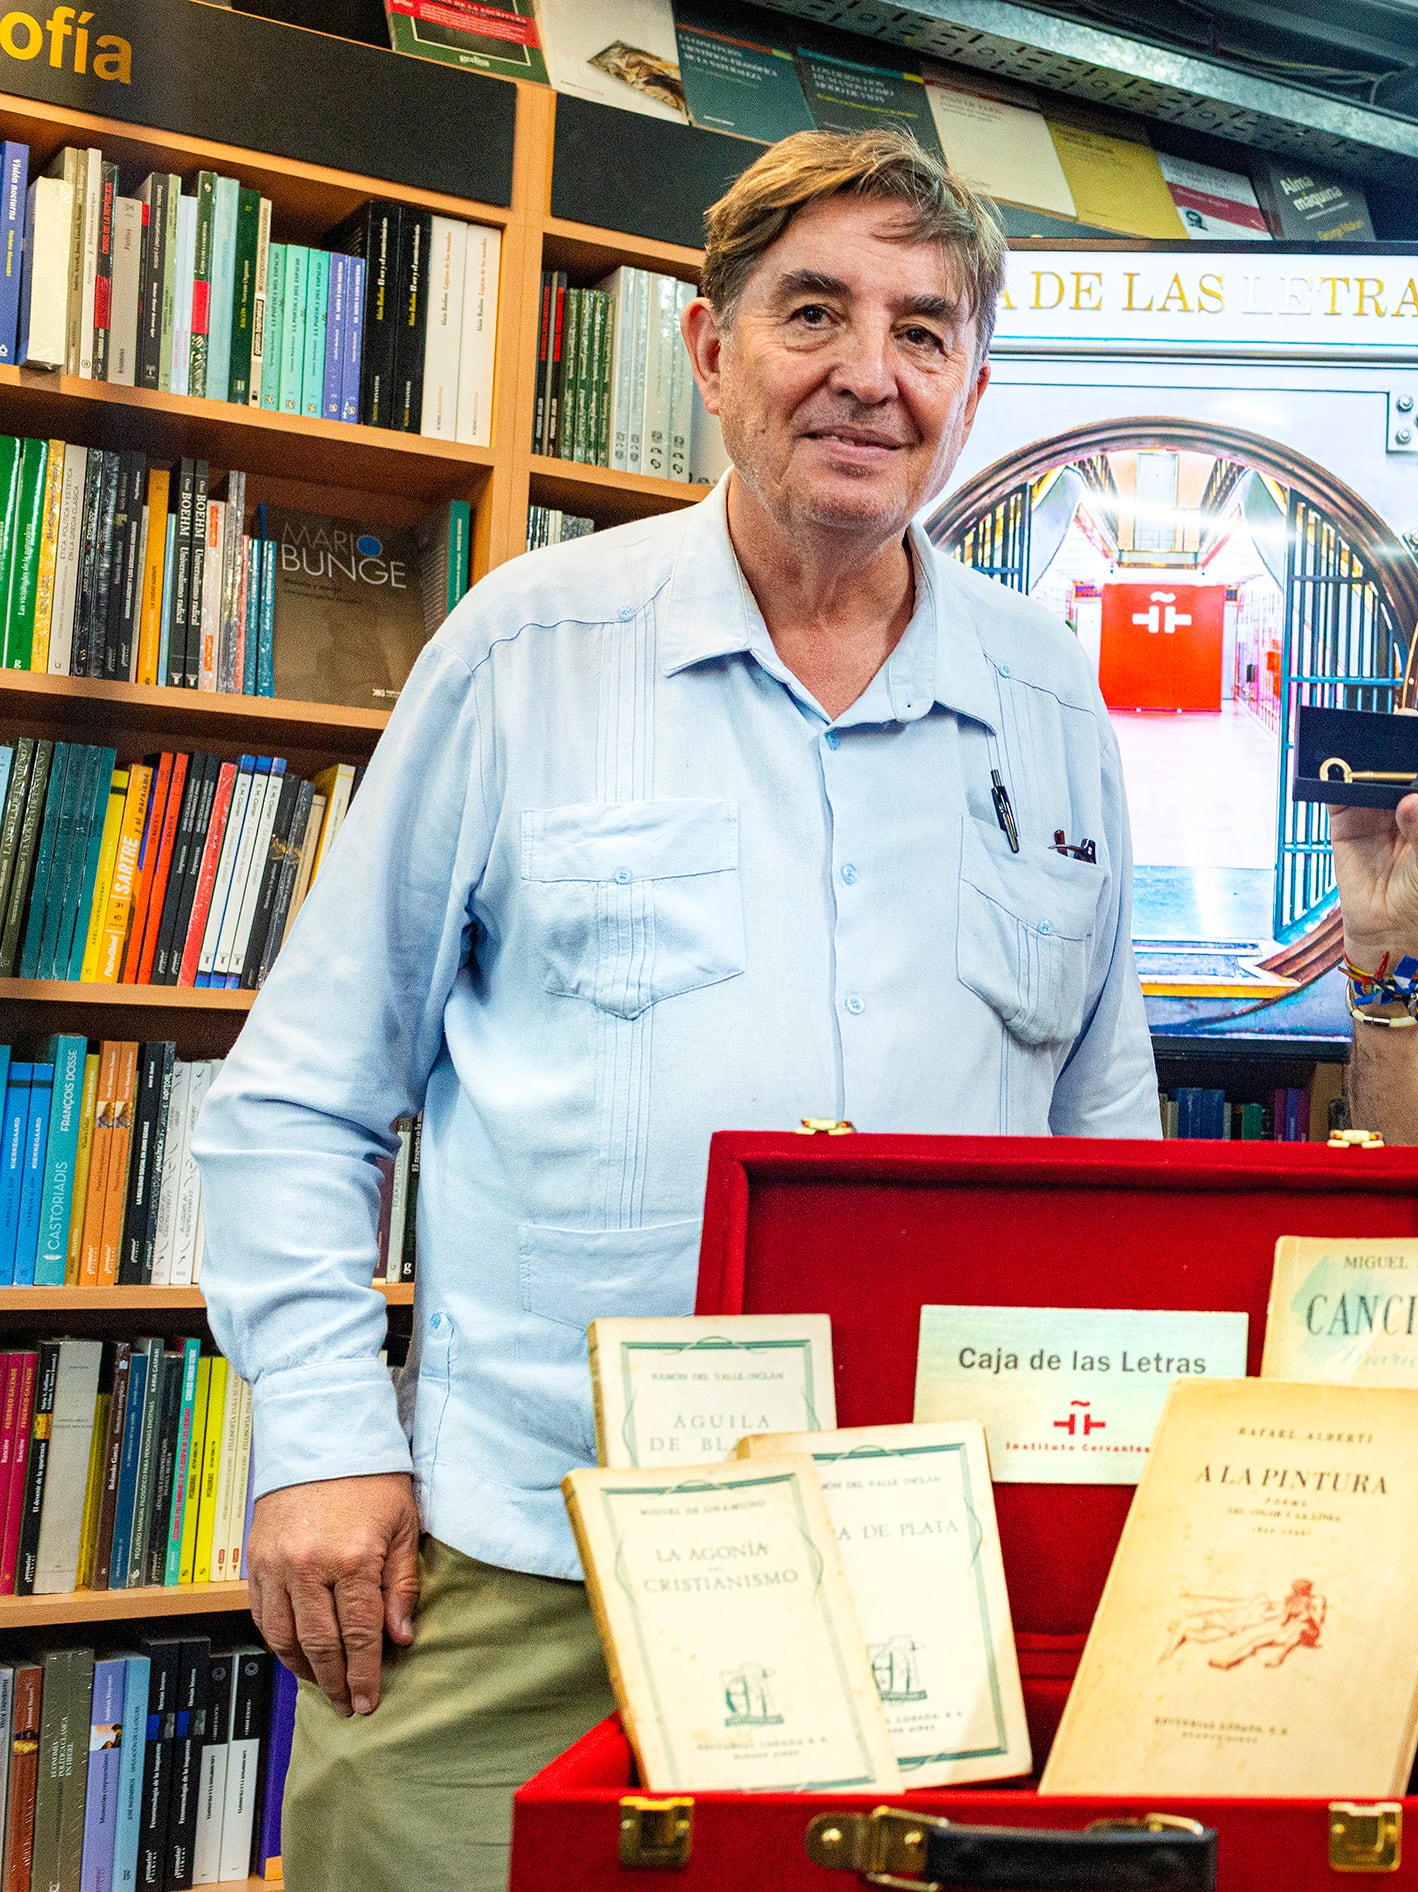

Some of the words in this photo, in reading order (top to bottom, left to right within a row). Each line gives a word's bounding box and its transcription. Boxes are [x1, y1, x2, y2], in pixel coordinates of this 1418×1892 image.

[0, 7, 133, 85] ofía
[10, 157, 22, 184] Visión
[1281, 176, 1316, 195] Alma
[8, 184, 20, 221] nocturna
[1293, 185, 1345, 212] máquina
[1029, 270, 1103, 312] DE
[1121, 270, 1226, 313] LAS
[239, 307, 247, 328] BACON
[178, 491, 192, 537] BOEHM
[193, 494, 207, 539] BOEHM
[281, 520, 383, 558] MARIO
[176, 546, 190, 599] Universalismo
[191, 548, 204, 600] Universalismo
[280, 543, 407, 590] BUNGE
[175, 599, 185, 625] radical
[190, 600, 200, 626] radical
[114, 834, 139, 894] SARTRE
[65, 1049, 78, 1082] DOSSE
[60, 1083, 75, 1132] FRANÇOIS
[10, 1117, 21, 1170] KIERKEGAARD
[31, 1117, 42, 1170] KIERKEGAARD
[47, 1161, 68, 1251] CASTORIADIS
[1343, 1255, 1409, 1271] MIGUEL
[957, 1345, 1020, 1377] Caja
[1029, 1347, 1061, 1372] de
[1072, 1347, 1112, 1373] las
[1120, 1348, 1209, 1376] Letras
[5, 1400, 15, 1430] FEDERICO
[20, 1400, 30, 1429] FEDERICO
[673, 1410, 772, 1430] ÁGUILA
[649, 1436, 682, 1452] DE
[1004, 1440, 1076, 1452] Instituto
[1080, 1440, 1153, 1454] Cervantes
[1237, 1425, 1296, 1441] RAFAEL
[1307, 1430, 1374, 1445] ALBERTI
[111, 1443, 120, 1466] García
[1195, 1464, 1213, 1484] A
[1219, 1465, 1254, 1487] LA
[1261, 1467, 1389, 1496] PINTURA
[863, 1522, 893, 1540] DE
[899, 1518, 958, 1539] PLATA
[655, 1544, 681, 1563] LA
[687, 1539, 770, 1563] AGONÍA
[643, 1566, 800, 1595] CRISTIANISMO
